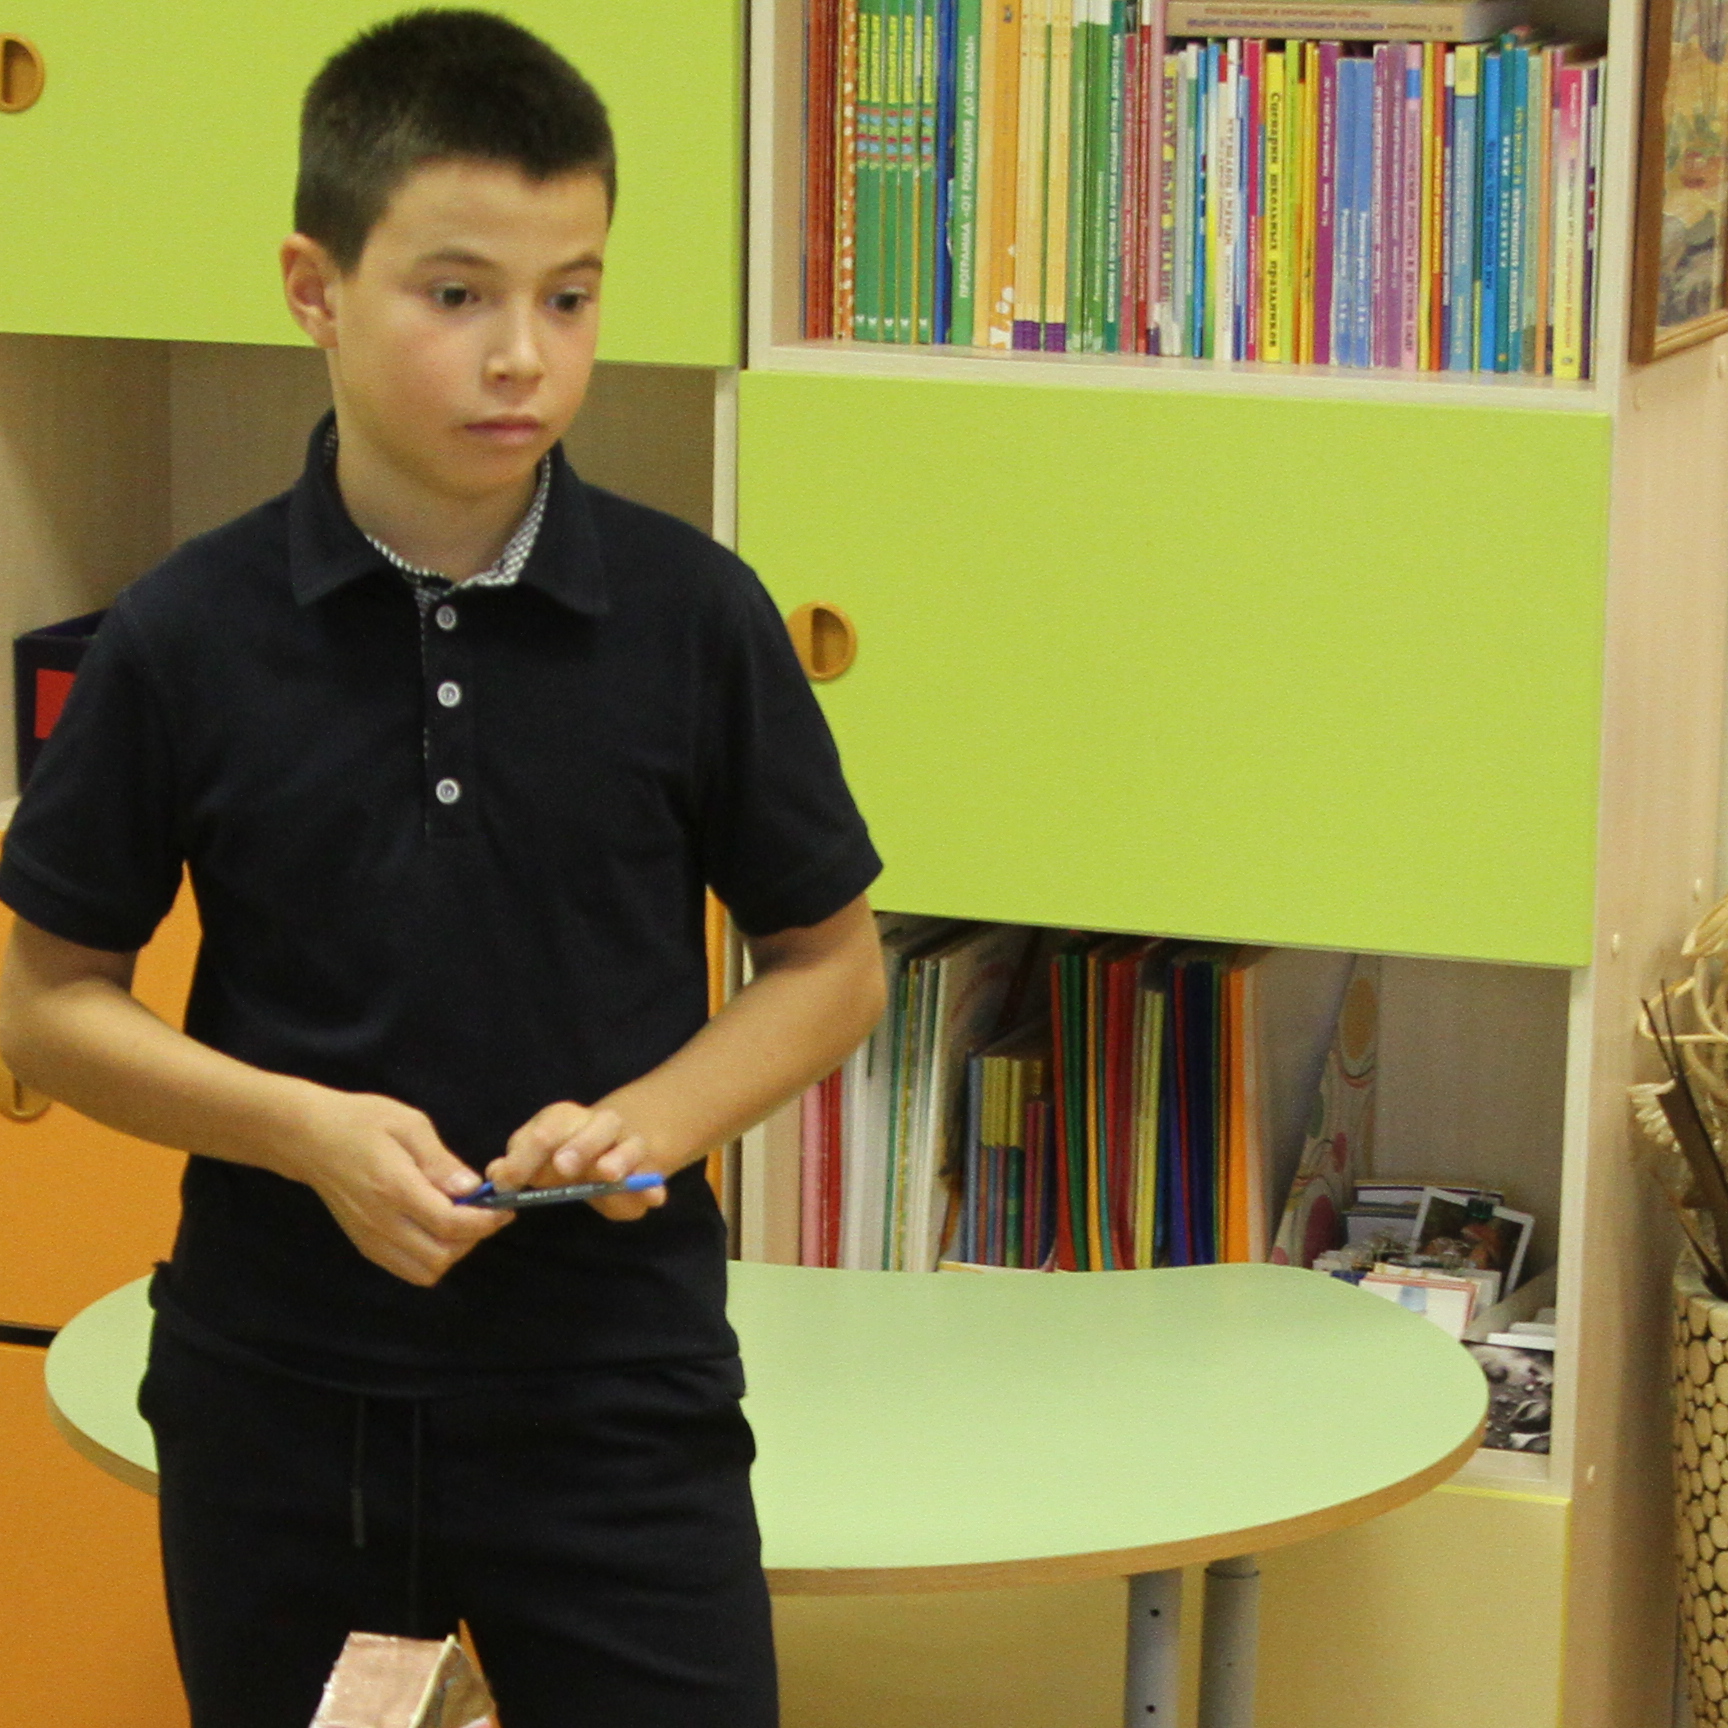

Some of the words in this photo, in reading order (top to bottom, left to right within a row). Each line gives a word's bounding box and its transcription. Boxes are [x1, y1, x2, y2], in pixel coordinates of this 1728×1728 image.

[962, 96, 975, 116] ДО
[1267, 92, 1281, 165] Сценарии
[961, 119, 974, 191] РОЖДЕНИЯ
[1268, 173, 1280, 251] школьных
[959, 222, 972, 299] ПРОГРАММА
[1267, 259, 1281, 348] праздников
